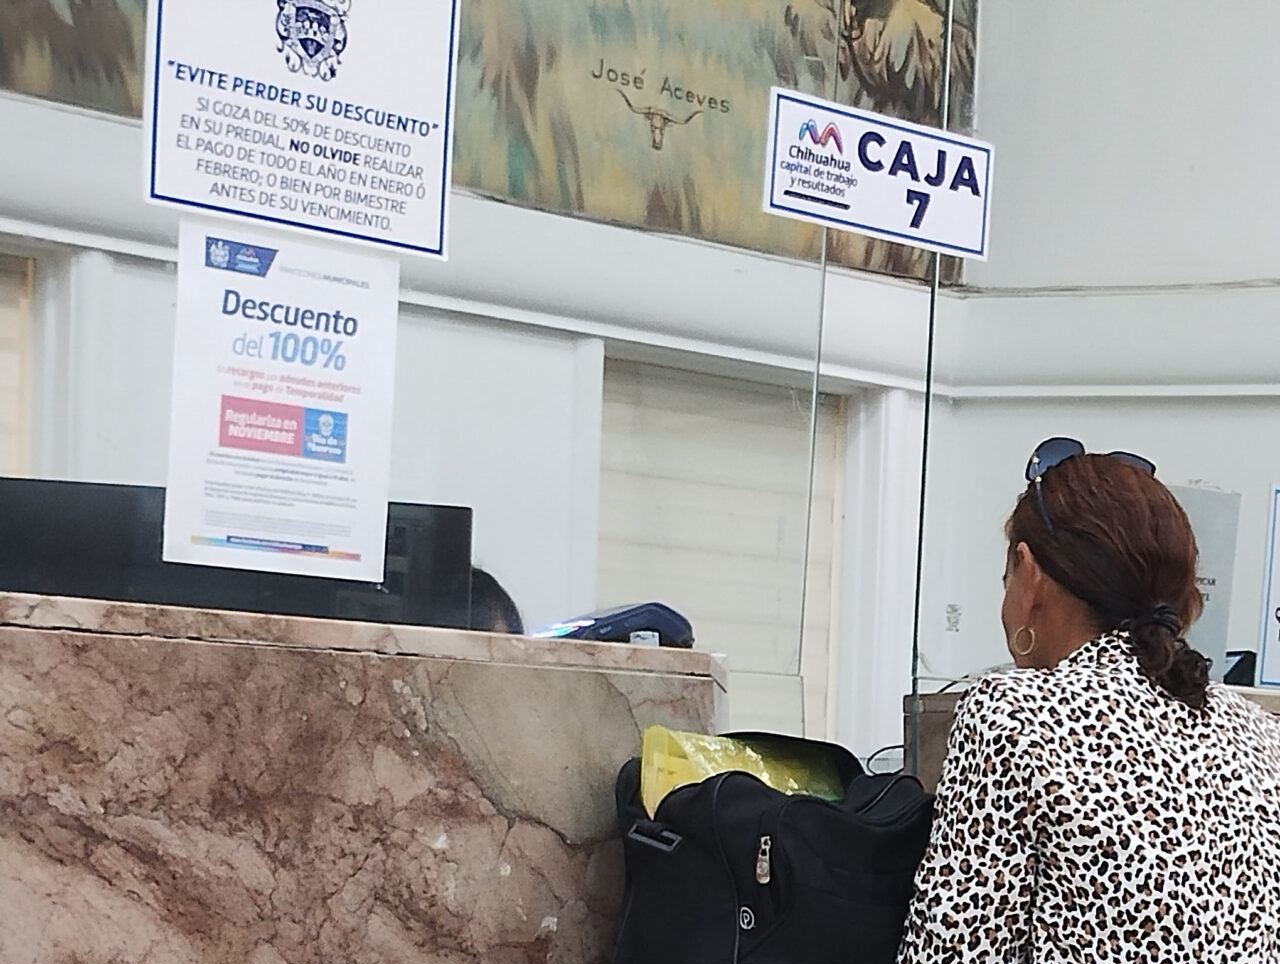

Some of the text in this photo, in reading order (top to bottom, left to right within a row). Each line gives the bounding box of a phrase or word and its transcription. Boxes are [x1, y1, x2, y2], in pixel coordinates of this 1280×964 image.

[232, 76, 300, 107] PERDER
[305, 94, 327, 113] SU
[591, 58, 730, 113] José Aceves
[180, 114, 200, 130] EN
[204, 119, 222, 135] SU
[289, 138, 309, 155] NO
[313, 143, 360, 166] OLVIDE
[364, 154, 424, 180] REALIZAR
[197, 97, 411, 158] SI GOZA DEL 50% DE DESCUENTO
[176, 133, 192, 150] EL
[196, 138, 234, 160] PAGO
[237, 147, 255, 163] DE
[260, 152, 296, 173] TODO
[300, 160, 315, 175] EL
[317, 160, 347, 183] AÑO
[350, 170, 368, 186] EN
[371, 175, 414, 198] ENERO
[780, 160, 858, 188] capital de trabajo
[788, 145, 851, 172] Chihuahua
[857, 131, 982, 197] CAJA
[209, 182, 393, 231] ANTES DE SU VENCIMIENTO.
[267, 172, 276, 188] O
[280, 175, 311, 194] BIEN
[314, 182, 341, 200] POR
[344, 187, 407, 216] BIMESTRE
[790, 177, 845, 197] y resultados
[906, 188, 931, 229] 7
[222, 289, 358, 337] Descuento
[232, 331, 347, 371] del 100%
[228, 425, 295, 445] NOVIEMBRE
